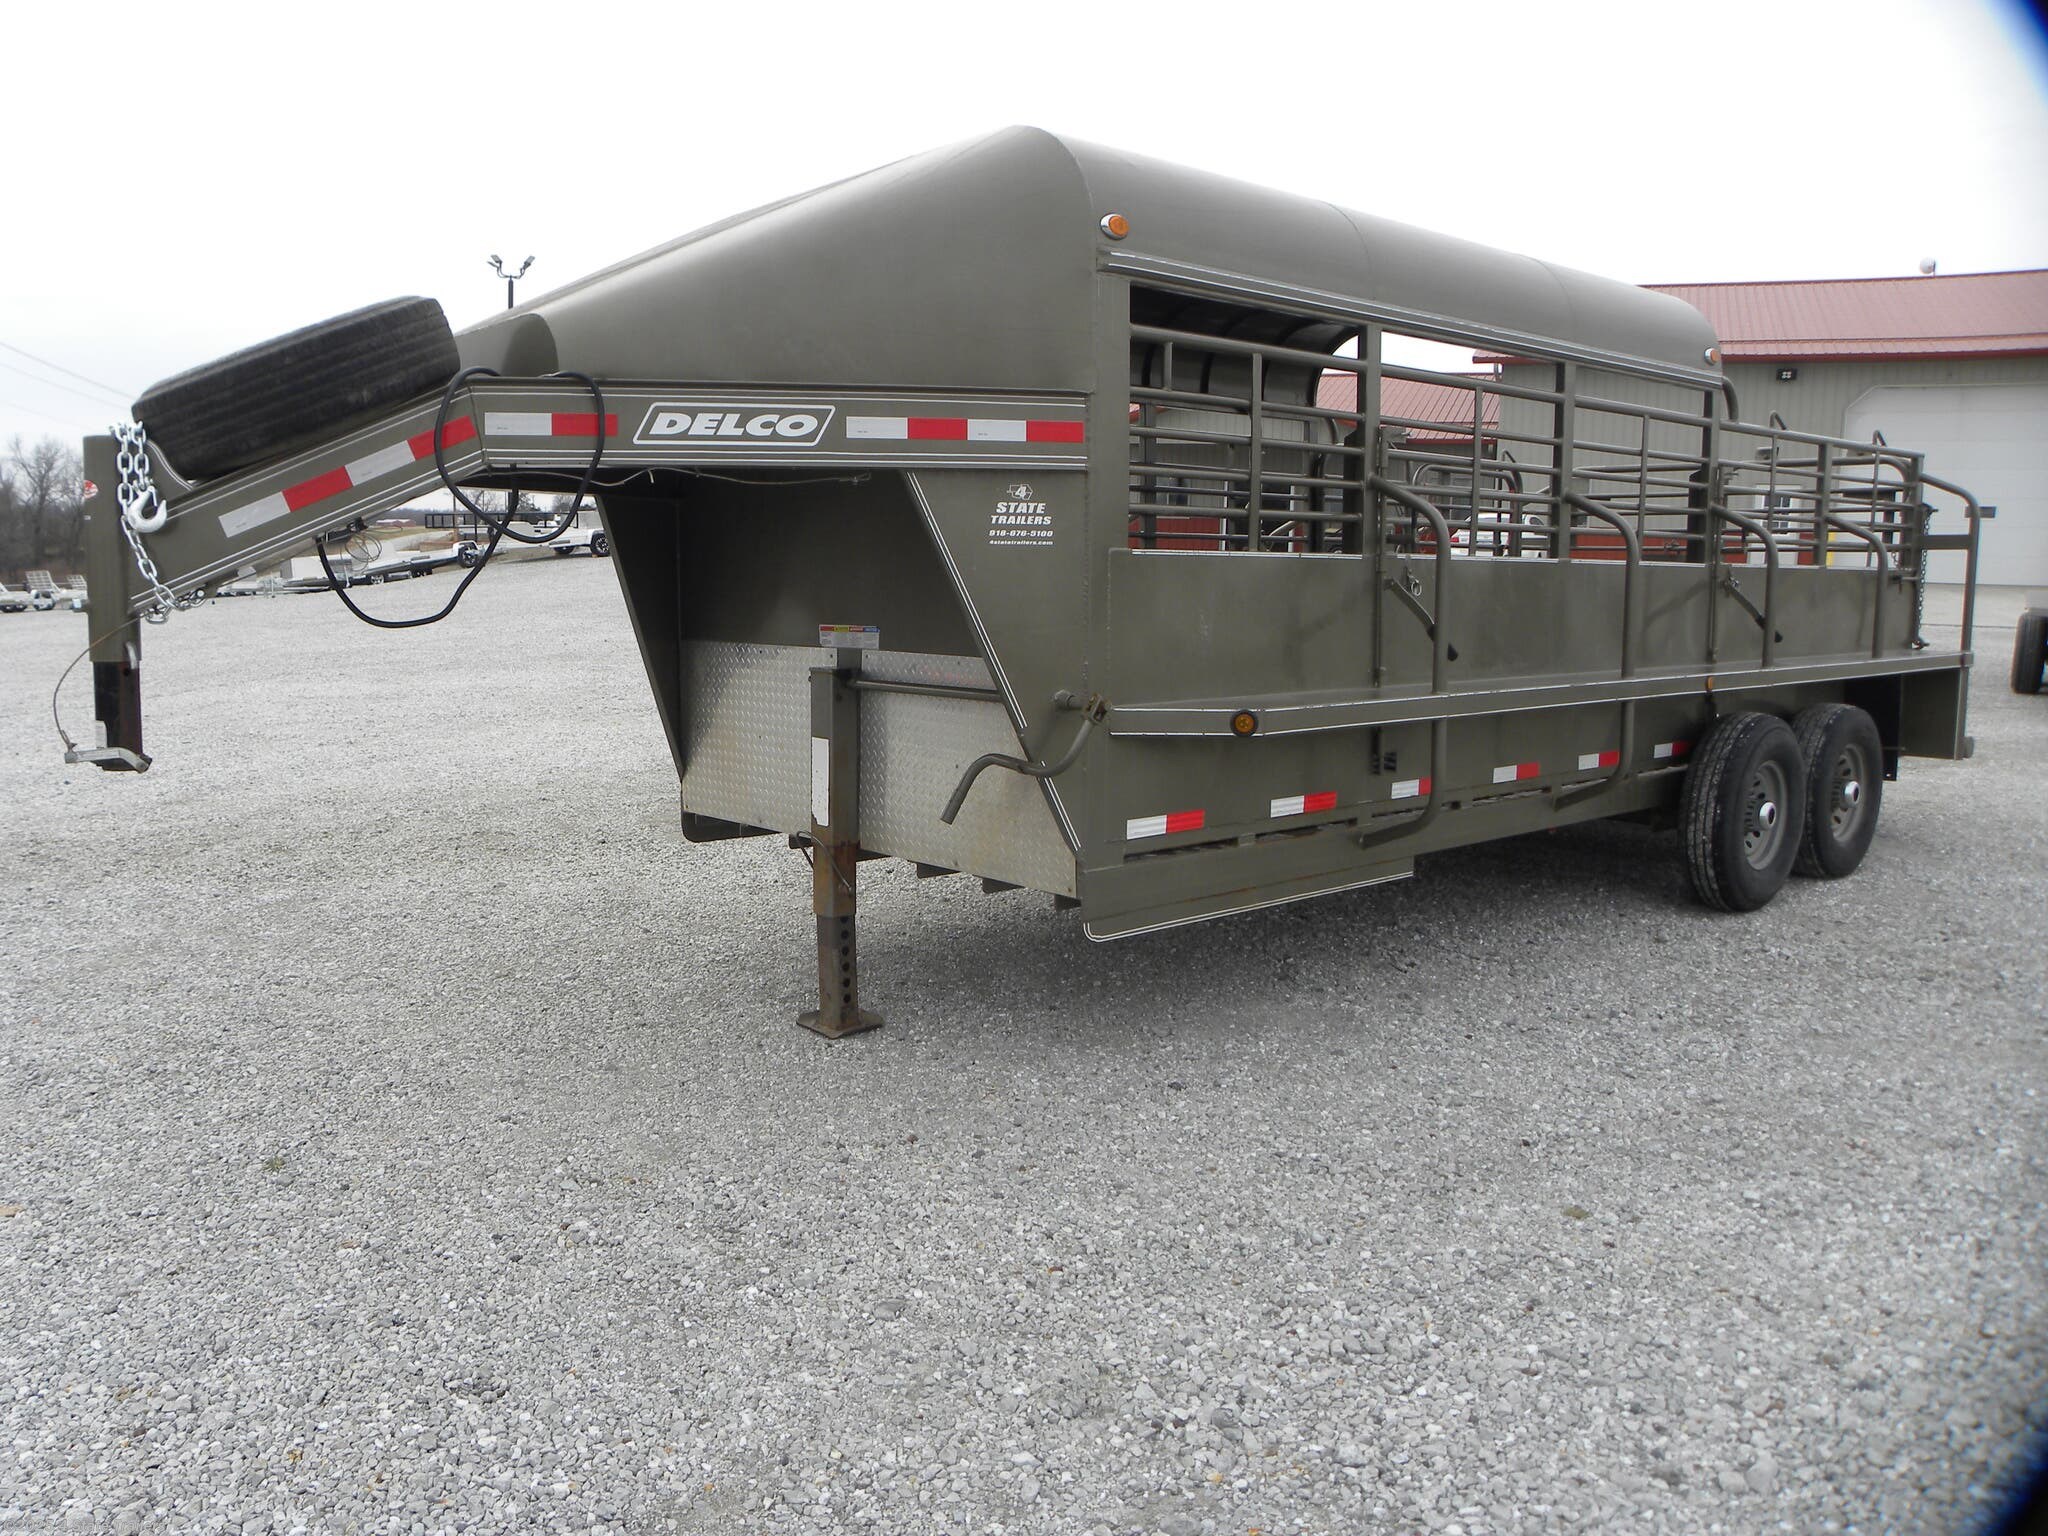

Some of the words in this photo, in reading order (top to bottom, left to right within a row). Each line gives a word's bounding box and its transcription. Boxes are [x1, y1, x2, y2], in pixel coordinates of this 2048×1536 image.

[649, 412, 819, 437] DELCO
[996, 502, 1046, 514] STATE
[990, 515, 1052, 525] TRAILERS
